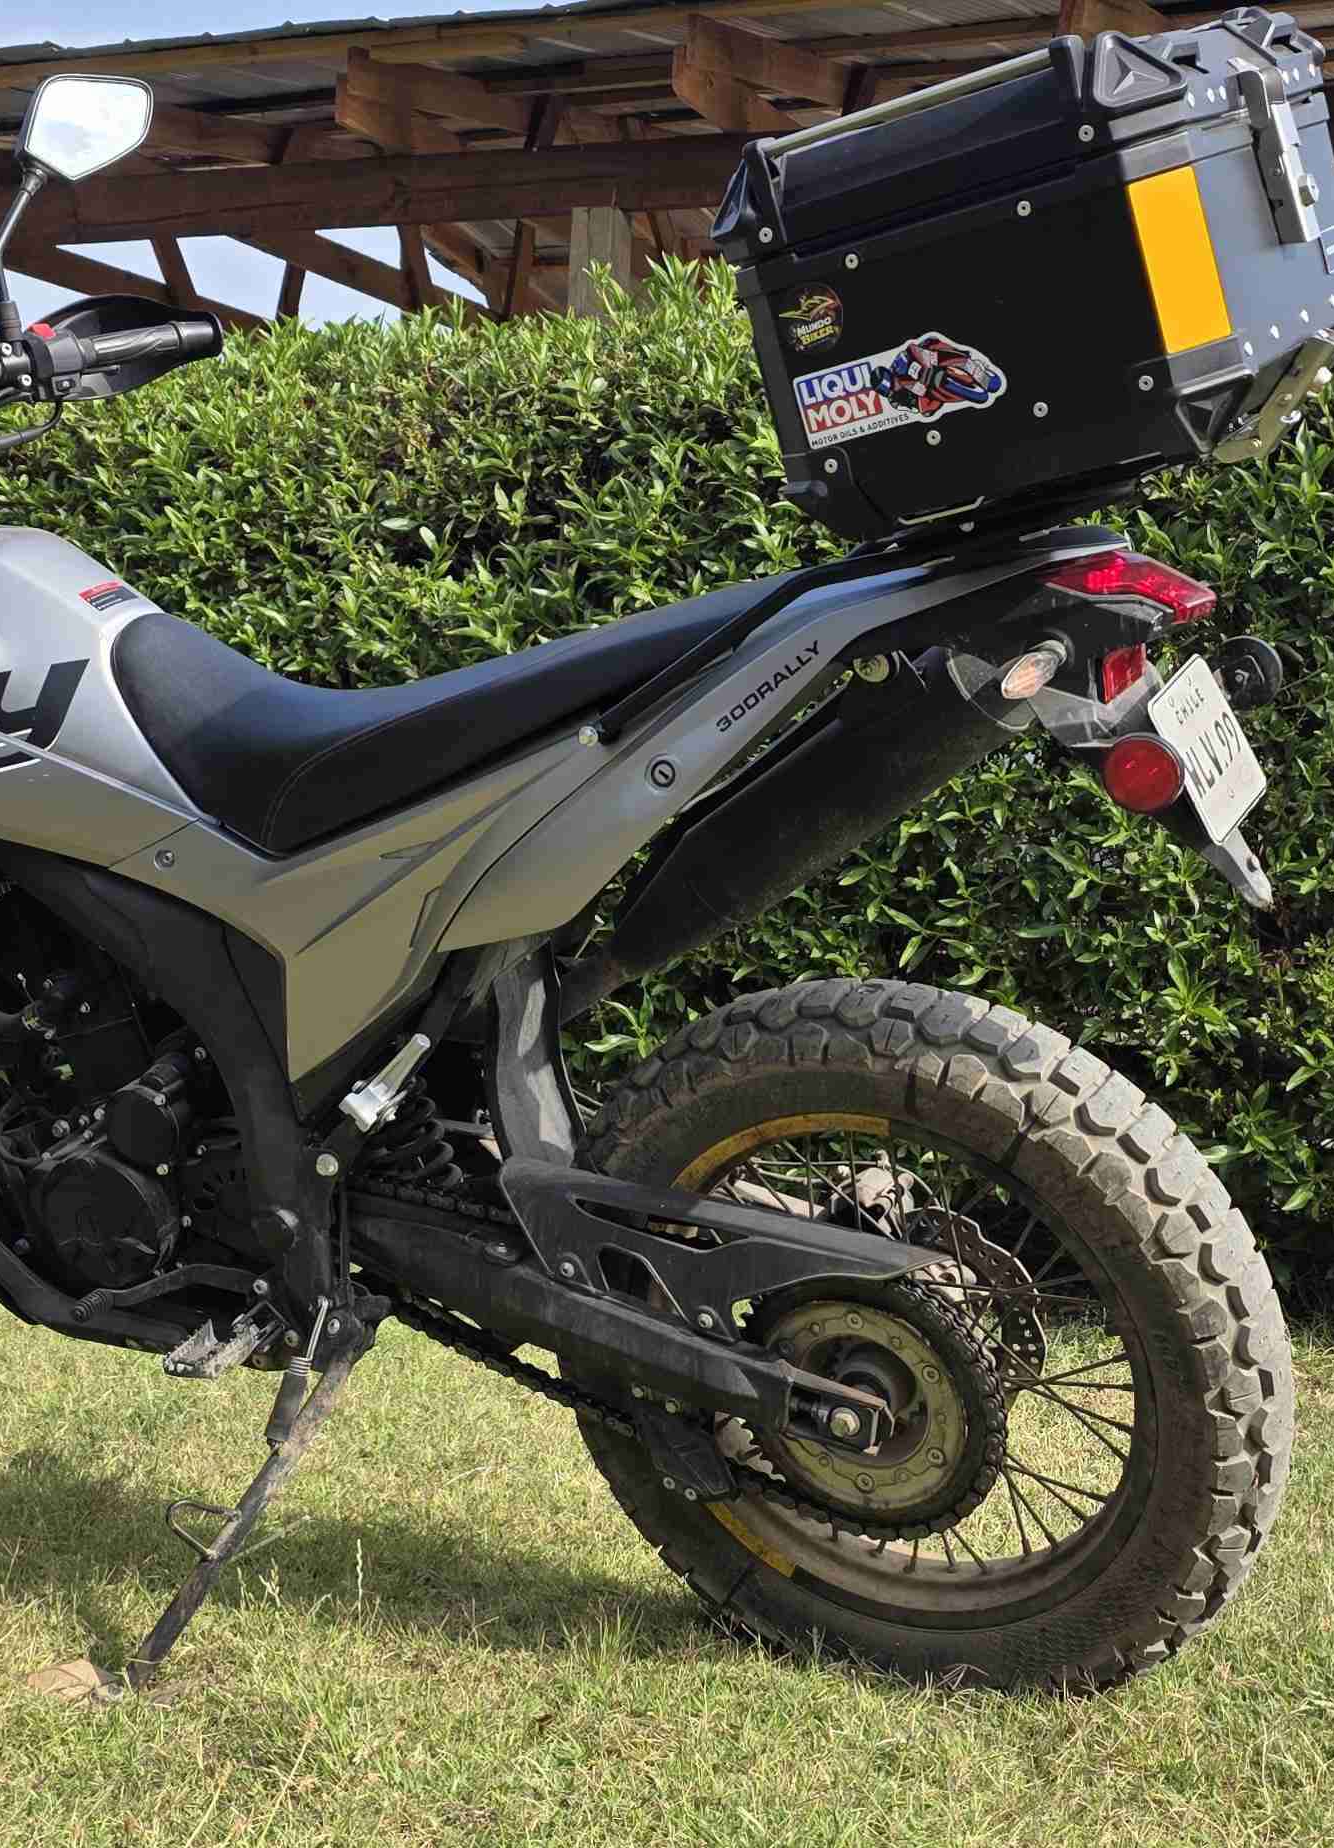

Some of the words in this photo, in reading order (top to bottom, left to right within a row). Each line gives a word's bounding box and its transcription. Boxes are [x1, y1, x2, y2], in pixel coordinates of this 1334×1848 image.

[799, 364, 872, 406] LIQUI
[806, 390, 876, 432] MOLY
[811, 432, 838, 447] MOTOR
[867, 412, 910, 431] ADDITIVES
[716, 640, 821, 732] 300RALLY
[1174, 687, 1206, 726] CHILE
